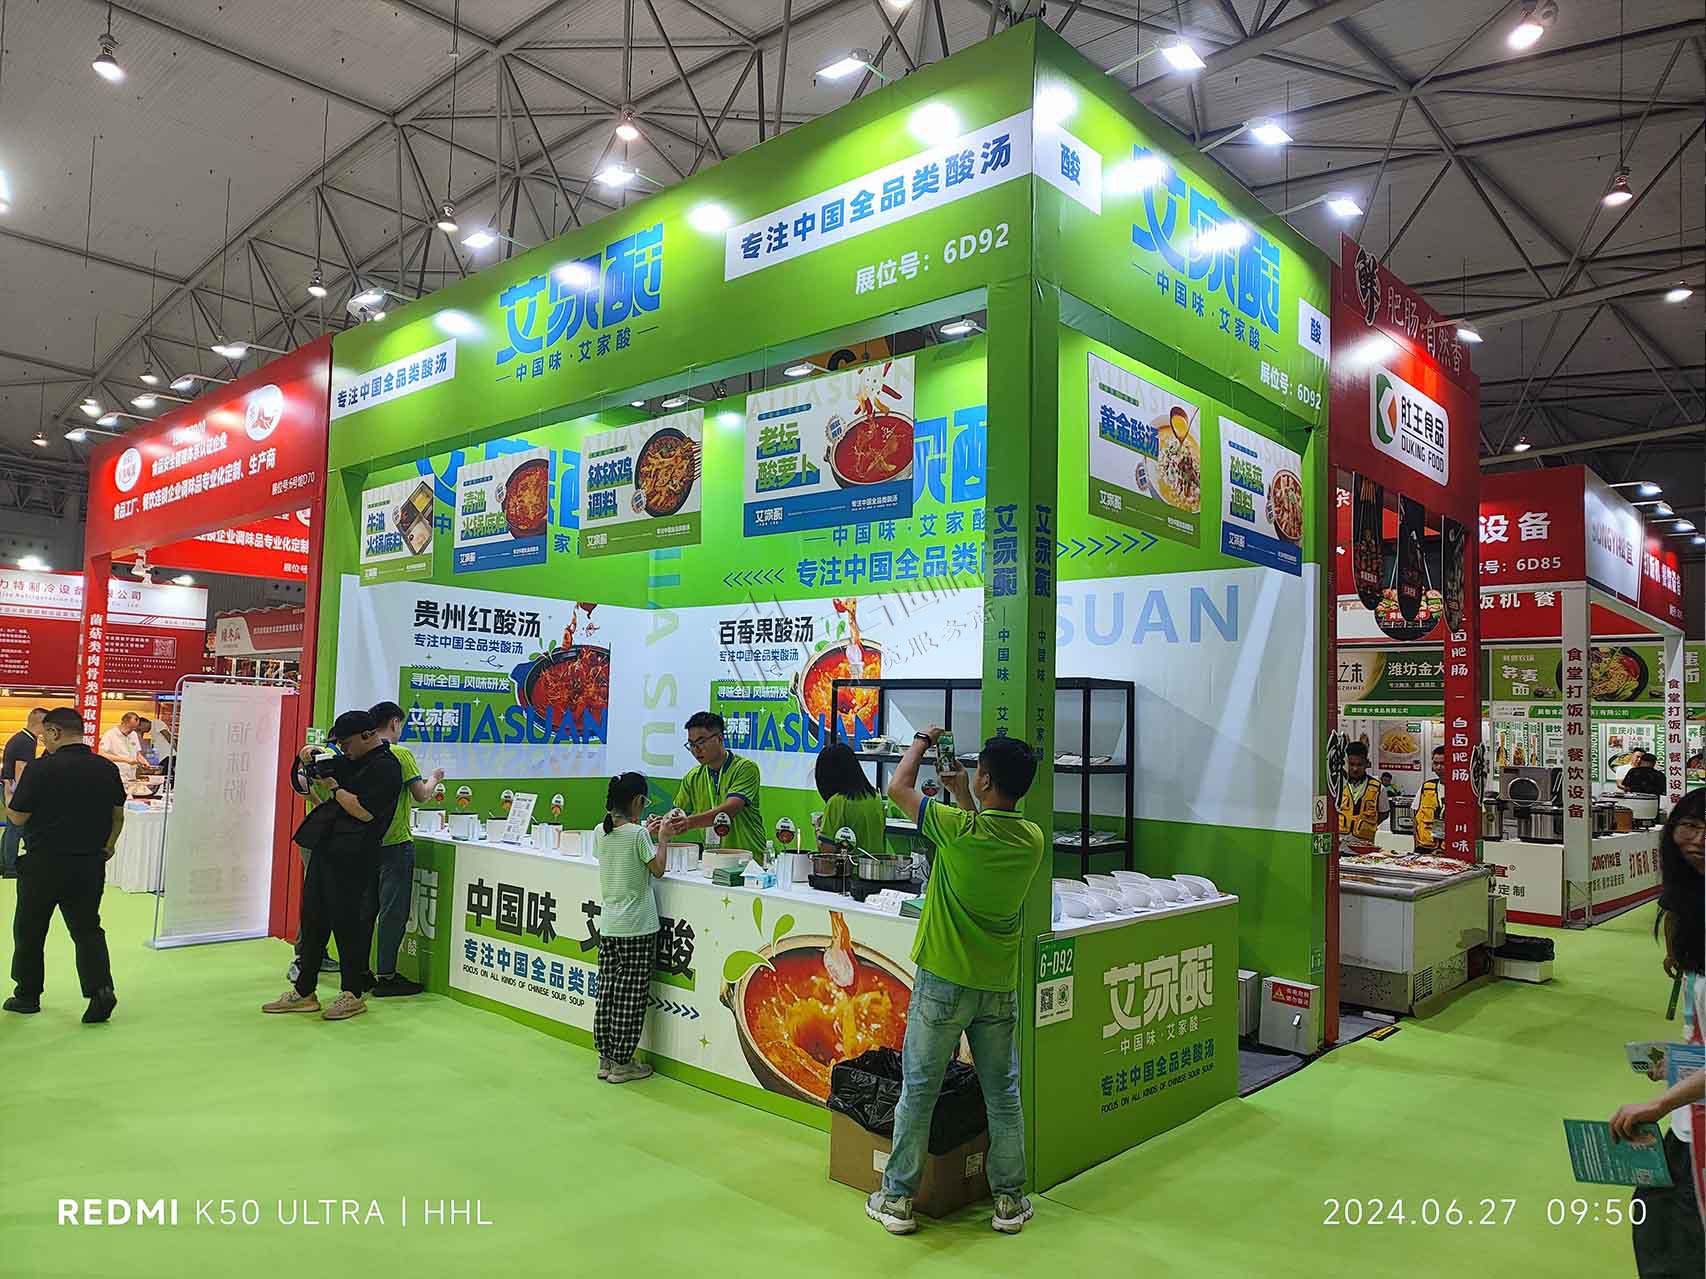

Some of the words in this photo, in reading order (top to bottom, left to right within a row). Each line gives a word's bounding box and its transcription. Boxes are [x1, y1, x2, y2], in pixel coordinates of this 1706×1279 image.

[1060, 143, 1081, 186] 酸
[740, 134, 1012, 260] 专注中国全品类酸汤
[1309, 316, 1322, 346] 酸
[337, 351, 448, 410] 专注中国全品类酸汤
[1401, 395, 1444, 450] 肚王食品
[1401, 436, 1426, 464] DUKING
[1427, 451, 1445, 474] FOOD
[1480, 511, 1551, 544] 设备
[797, 542, 985, 588] 专注中国全品类
[413, 600, 541, 639] 贵州红酸汤
[718, 615, 814, 645] 百香果酸汤
[414, 633, 524, 655] 专注中国全品类酸汤
[719, 648, 799, 663] 专注中国全品类酸汤
[410, 672, 460, 690] 寻味全国
[463, 675, 511, 692] 风味研发
[716, 686, 751, 699] 寻味全国
[751, 686, 789, 700] 风味研发
[1566, 647, 1584, 736] 食堂打饭机
[723, 717, 751, 735] 家酸
[1667, 678, 1681, 743] 食堂打饭机
[1567, 748, 1585, 818] 餐饮设备
[466, 878, 558, 945] 中国味
[580, 900, 696, 981] 艾酸
[1040, 948, 1073, 978] 6-D92
[463, 964, 478, 976] FOCUS
[480, 969, 489, 978] ON
[490, 972, 499, 981] ALL
[501, 975, 517, 986] KINDS
[518, 979, 526, 989] OF
[527, 982, 550, 998] CHINESE
[551, 989, 568, 1003] SOUR
[569, 992, 585, 1007] SOUP
[1101, 1038, 1214, 1097] 专注中国全品类酸汤
